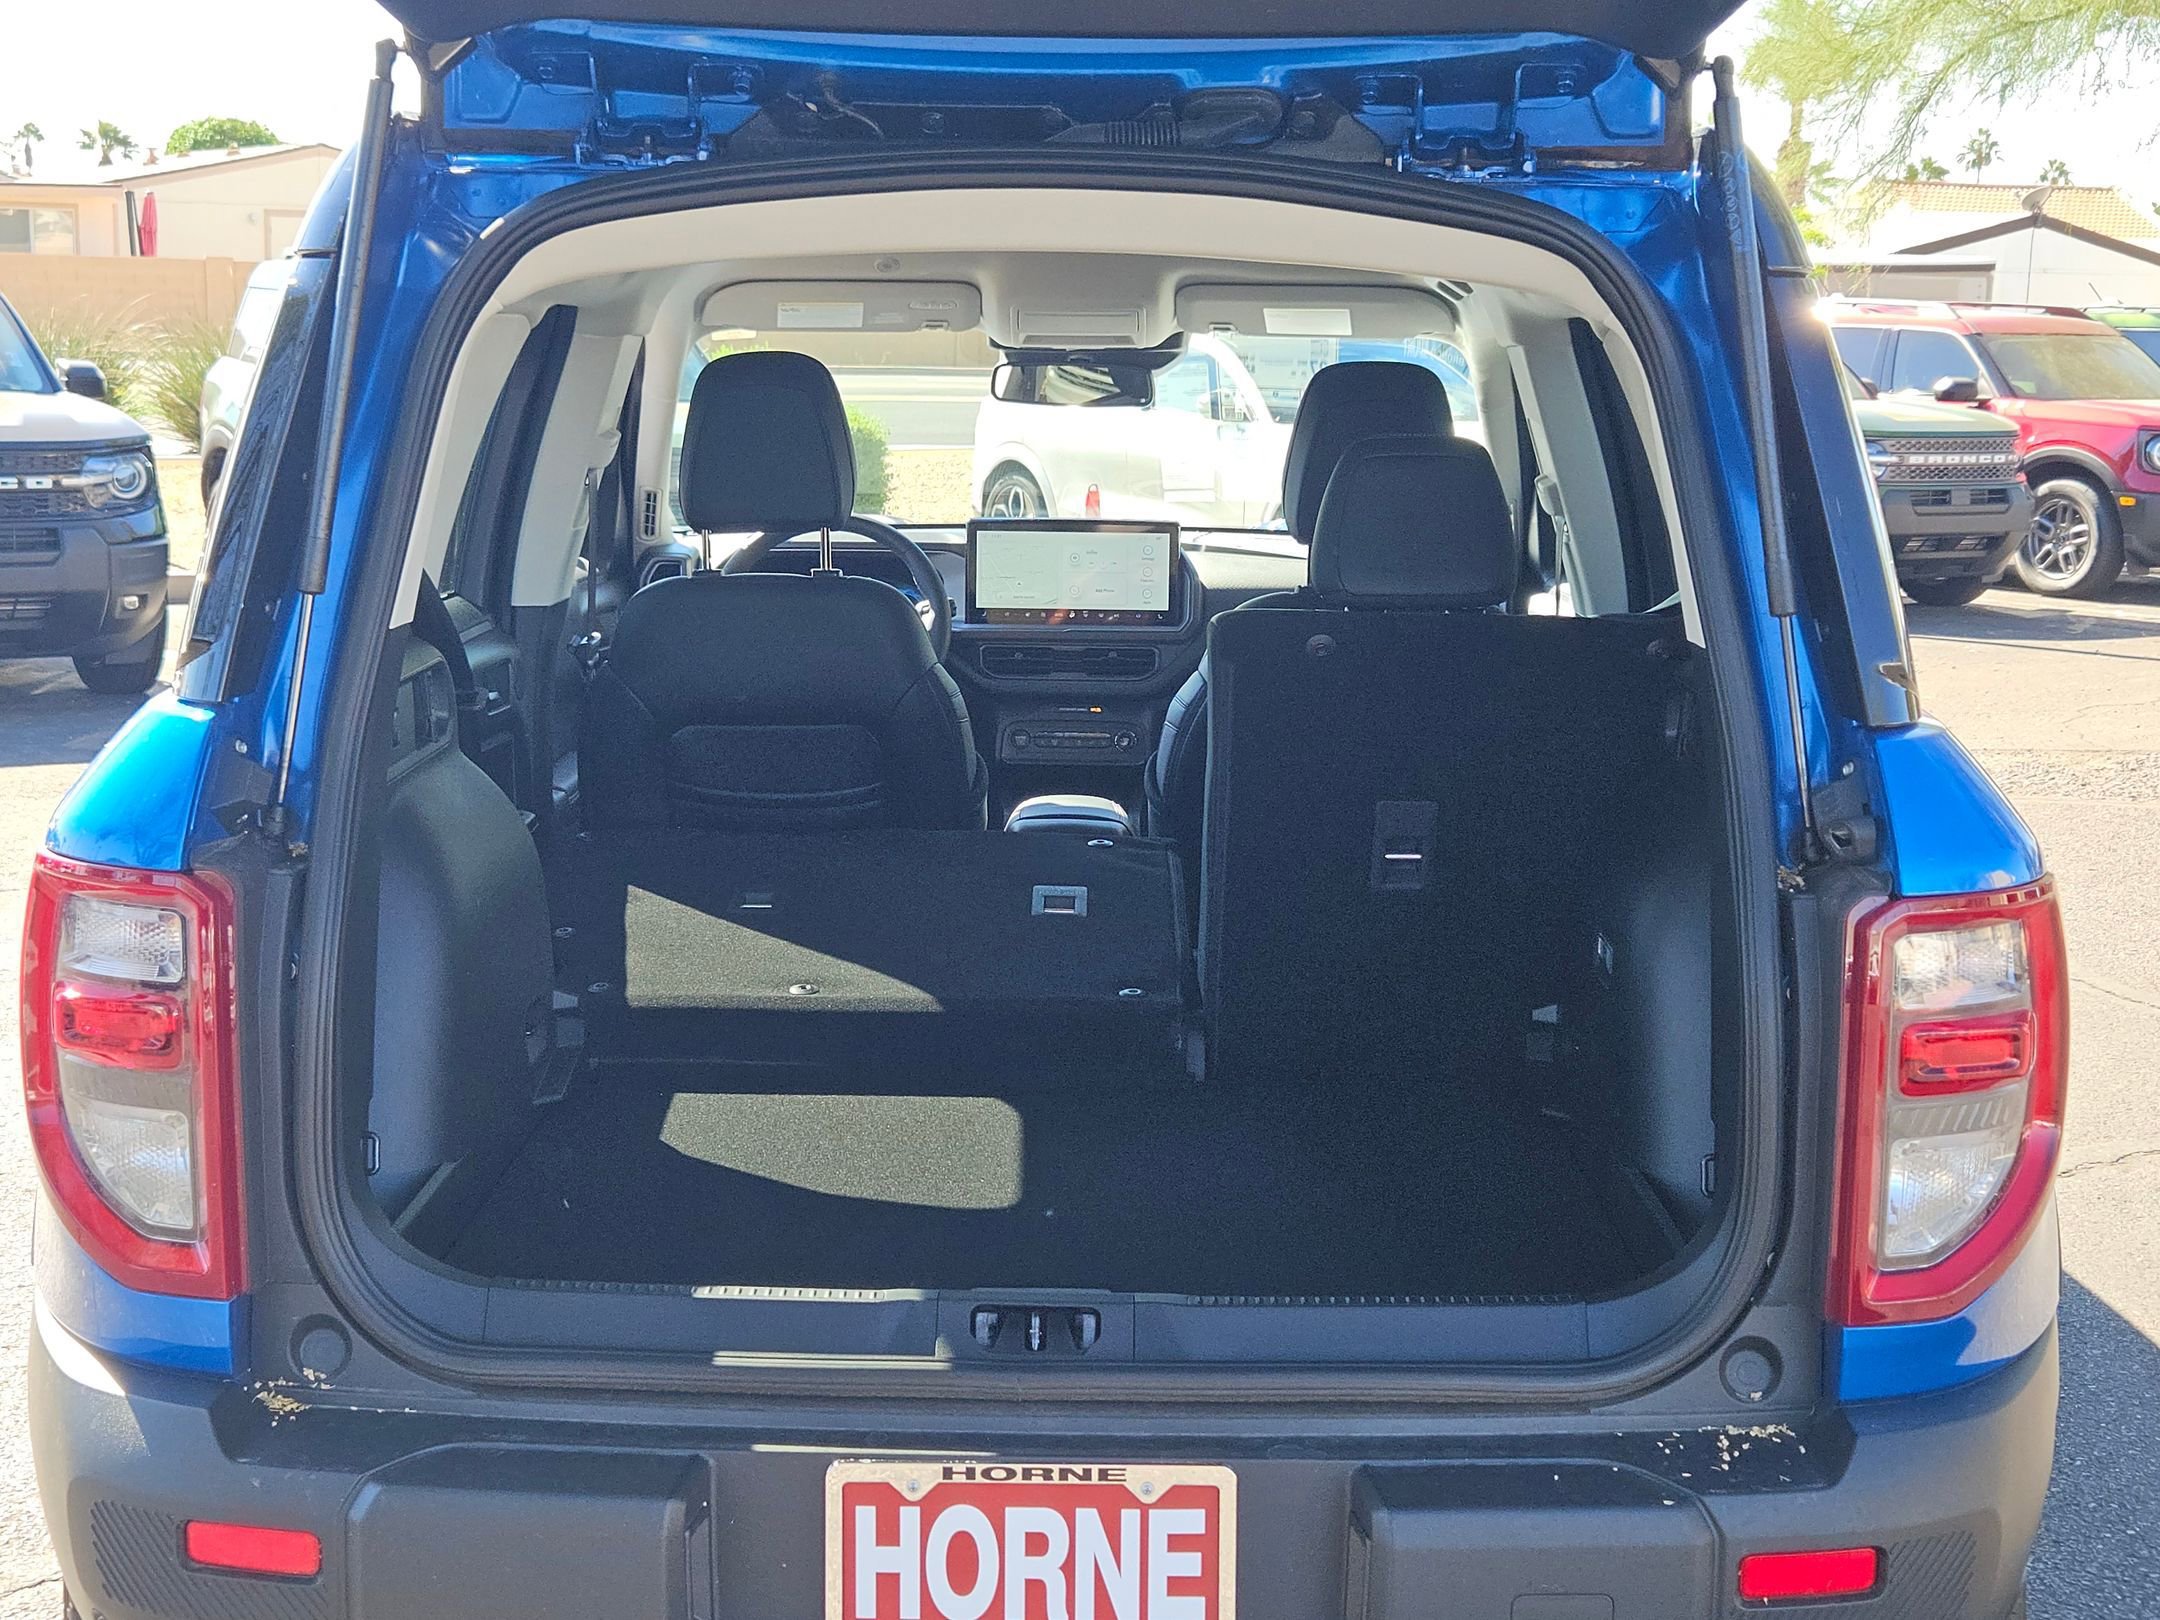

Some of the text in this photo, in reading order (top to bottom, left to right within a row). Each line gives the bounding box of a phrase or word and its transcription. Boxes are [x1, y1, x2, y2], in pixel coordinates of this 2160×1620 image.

[1908, 455, 2006, 464] BRONCO
[942, 1466, 1127, 1482] HORNE
[854, 1504, 1206, 1620] HORNE
